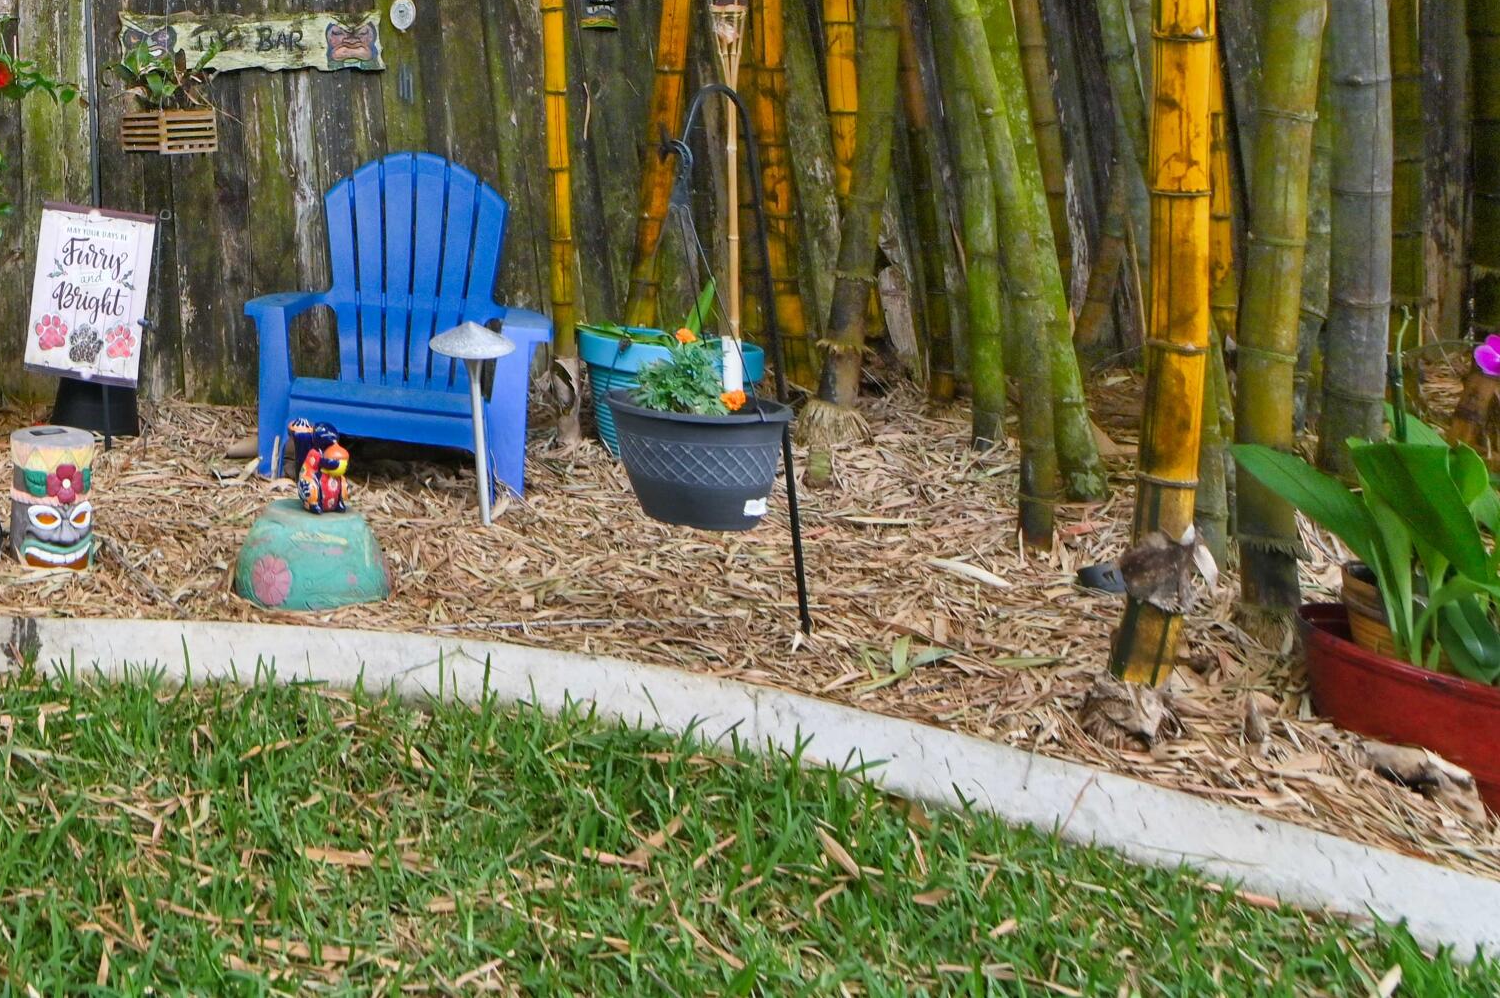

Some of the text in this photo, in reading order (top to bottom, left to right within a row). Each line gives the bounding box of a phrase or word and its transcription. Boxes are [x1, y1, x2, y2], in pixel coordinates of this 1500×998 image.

[66, 226, 82, 234] MAY
[83, 228, 100, 237] YOUR
[102, 230, 119, 240] DAYS
[62, 237, 128, 281] Furry
[80, 270, 102, 283] and
[52, 281, 128, 324] Bright
